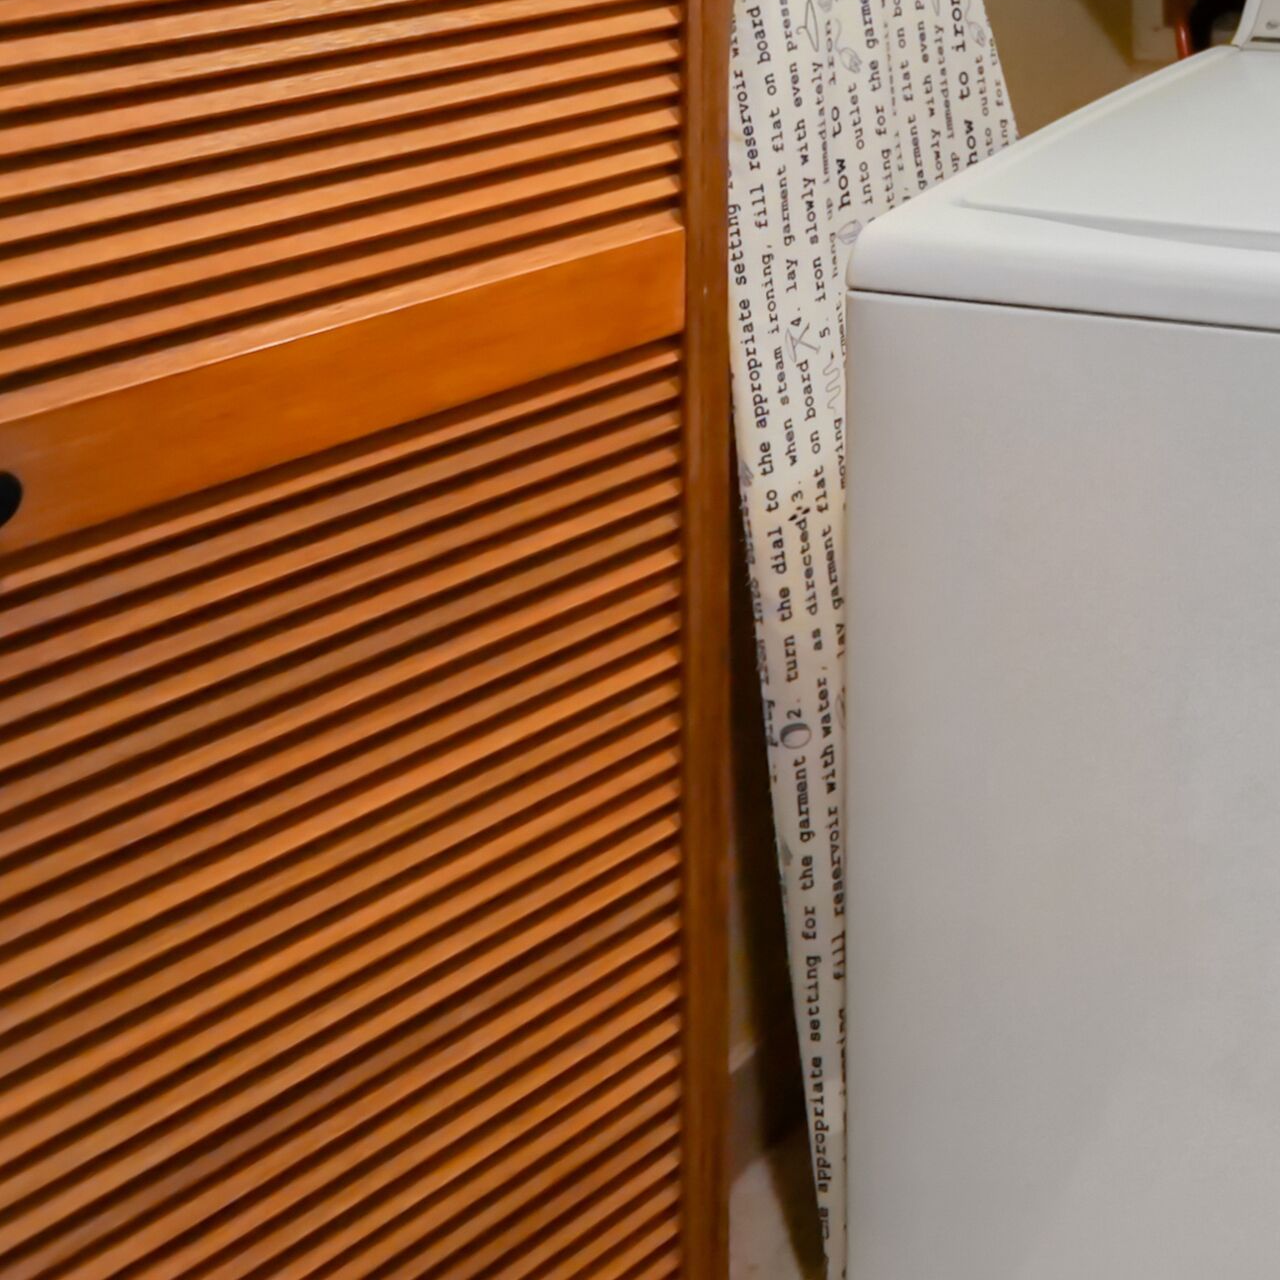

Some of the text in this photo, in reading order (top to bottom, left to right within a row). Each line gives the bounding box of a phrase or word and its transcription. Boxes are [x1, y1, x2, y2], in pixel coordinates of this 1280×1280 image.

[747, 5, 770, 64] board
[895, 27, 907, 49] on
[917, 20, 930, 63] even
[765, 73, 777, 96] on
[787, 62, 803, 108] even
[867, 60, 881, 92] the
[899, 59, 914, 102] flat
[922, 75, 936, 117] with
[933, 25, 955, 139] immediately
[958, 71, 970, 100] to
[993, 79, 1004, 107] for
[732, 69, 761, 171] reservoir
[768, 107, 784, 152] flat
[830, 106, 841, 138] to
[847, 82, 865, 150] outlet
[874, 105, 887, 136] for
[974, 55, 994, 157] nto outlet
[795, 118, 809, 166] with
[907, 114, 928, 190] garment
[930, 128, 945, 180] lowly
[963, 118, 979, 166] how
[835, 158, 851, 208] how
[858, 161, 874, 205] into
[877, 148, 896, 210] tting
[750, 183, 769, 229] fill
[776, 164, 795, 246] garment
[801, 177, 819, 244] slowly
[824, 197, 834, 220] up
[727, 204, 748, 286] setting
[760, 243, 781, 334] ironing,
[786, 258, 798, 292] lay
[811, 257, 826, 302] iron
[738, 299, 768, 429] appropriate
[773, 346, 790, 406] steam
[796, 359, 817, 420] board
[758, 442, 774, 476] the
[783, 418, 798, 466] when
[809, 430, 821, 454] on
[765, 490, 779, 512] to
[813, 465, 828, 513] flat
[768, 526, 787, 574] dial
[796, 518, 819, 615] directed
[822, 526, 843, 610] garment
[778, 587, 793, 622] the
[783, 635, 799, 682] turn
[811, 628, 823, 651] as
[820, 743, 838, 794] with
[792, 755, 815, 843] garment
[799, 855, 814, 890] the
[825, 806, 844, 917] reservoir
[801, 907, 817, 940] for
[804, 955, 822, 1042] setting
[809, 1056, 831, 1193] appropriate
